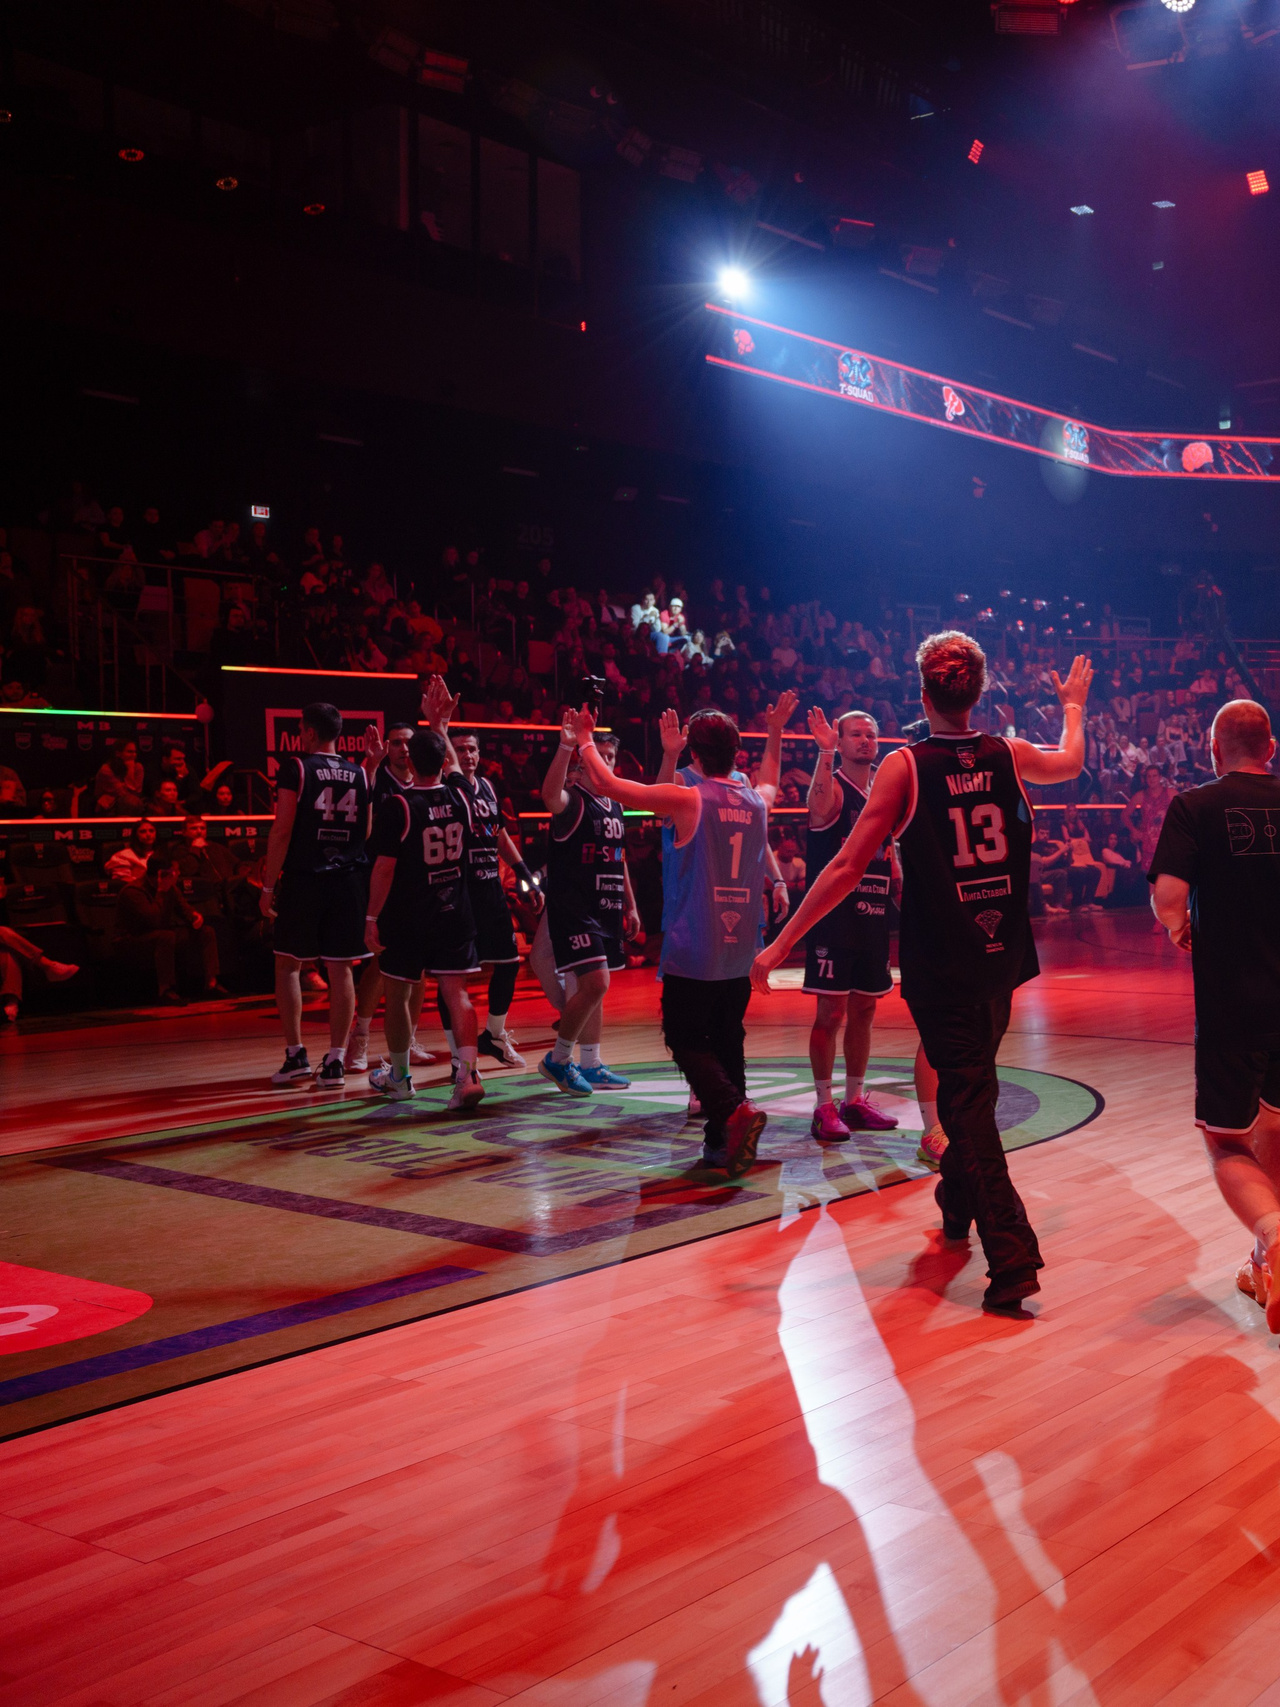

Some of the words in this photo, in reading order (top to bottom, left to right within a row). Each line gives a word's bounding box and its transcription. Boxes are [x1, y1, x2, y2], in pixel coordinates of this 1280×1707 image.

[839, 383, 874, 403] T-SQUAD
[315, 768, 357, 784] GUREEV
[945, 771, 994, 796] NIGHT
[314, 786, 358, 823] 44
[428, 805, 453, 820] JOKE
[717, 808, 753, 825] WOODS
[604, 817, 622, 839] 30
[948, 802, 1009, 868] 13
[422, 822, 464, 865] 69
[729, 832, 743, 879] 1
[568, 933, 592, 950] 30
[817, 958, 835, 979] 71
